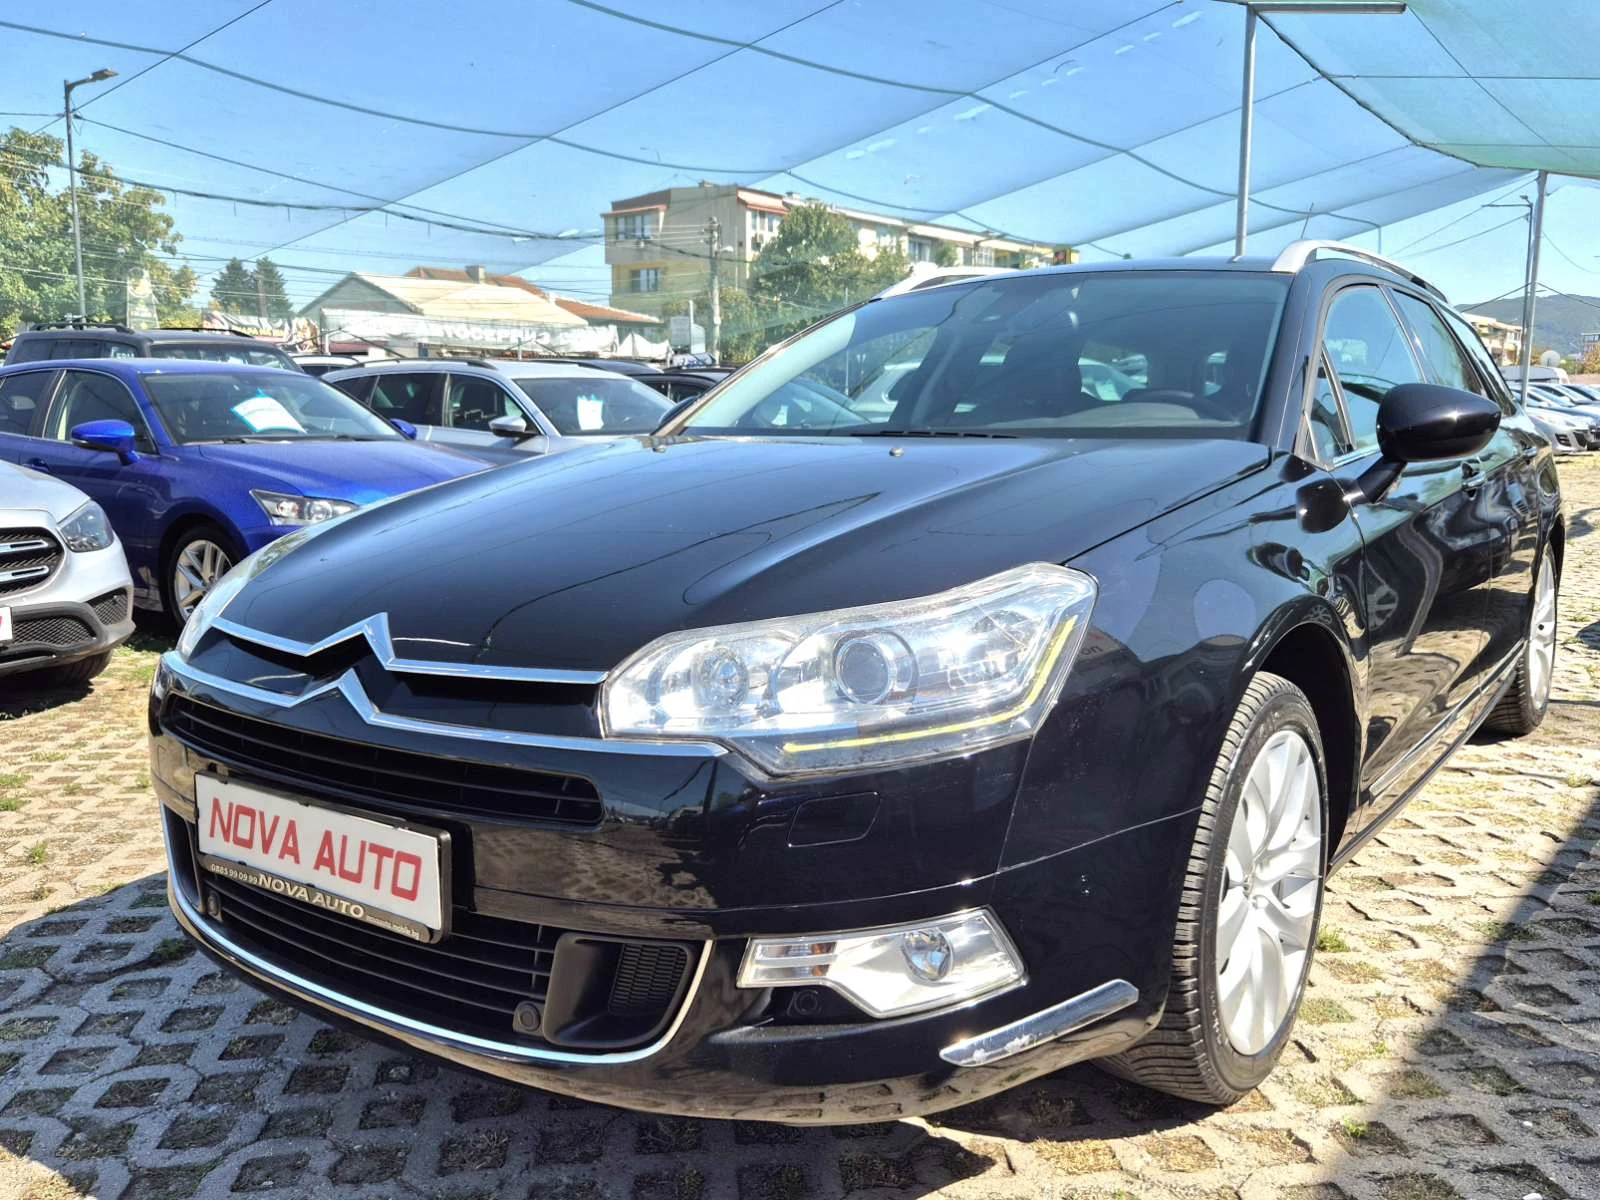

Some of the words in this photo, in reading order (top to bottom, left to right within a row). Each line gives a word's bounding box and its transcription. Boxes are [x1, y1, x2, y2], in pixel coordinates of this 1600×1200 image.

[209, 798, 301, 865] NOVA
[313, 829, 422, 901] AUTO
[260, 873, 310, 901] NOVA
[312, 892, 364, 919] AUTO
